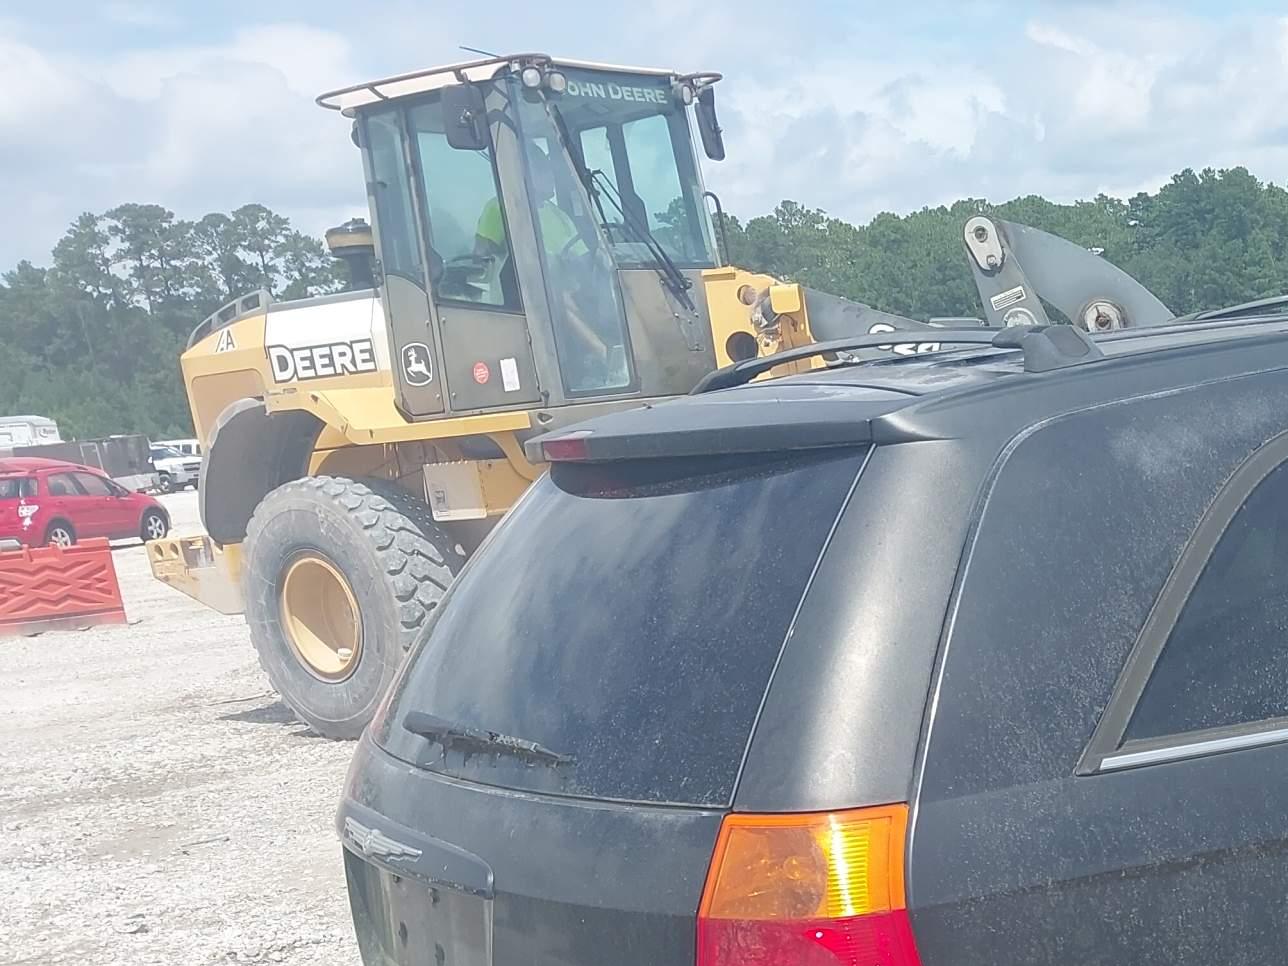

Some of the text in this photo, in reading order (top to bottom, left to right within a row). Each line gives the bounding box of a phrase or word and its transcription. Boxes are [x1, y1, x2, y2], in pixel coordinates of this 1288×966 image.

[560, 79, 668, 104] OHN DEERE
[267, 338, 378, 384] DEERE
